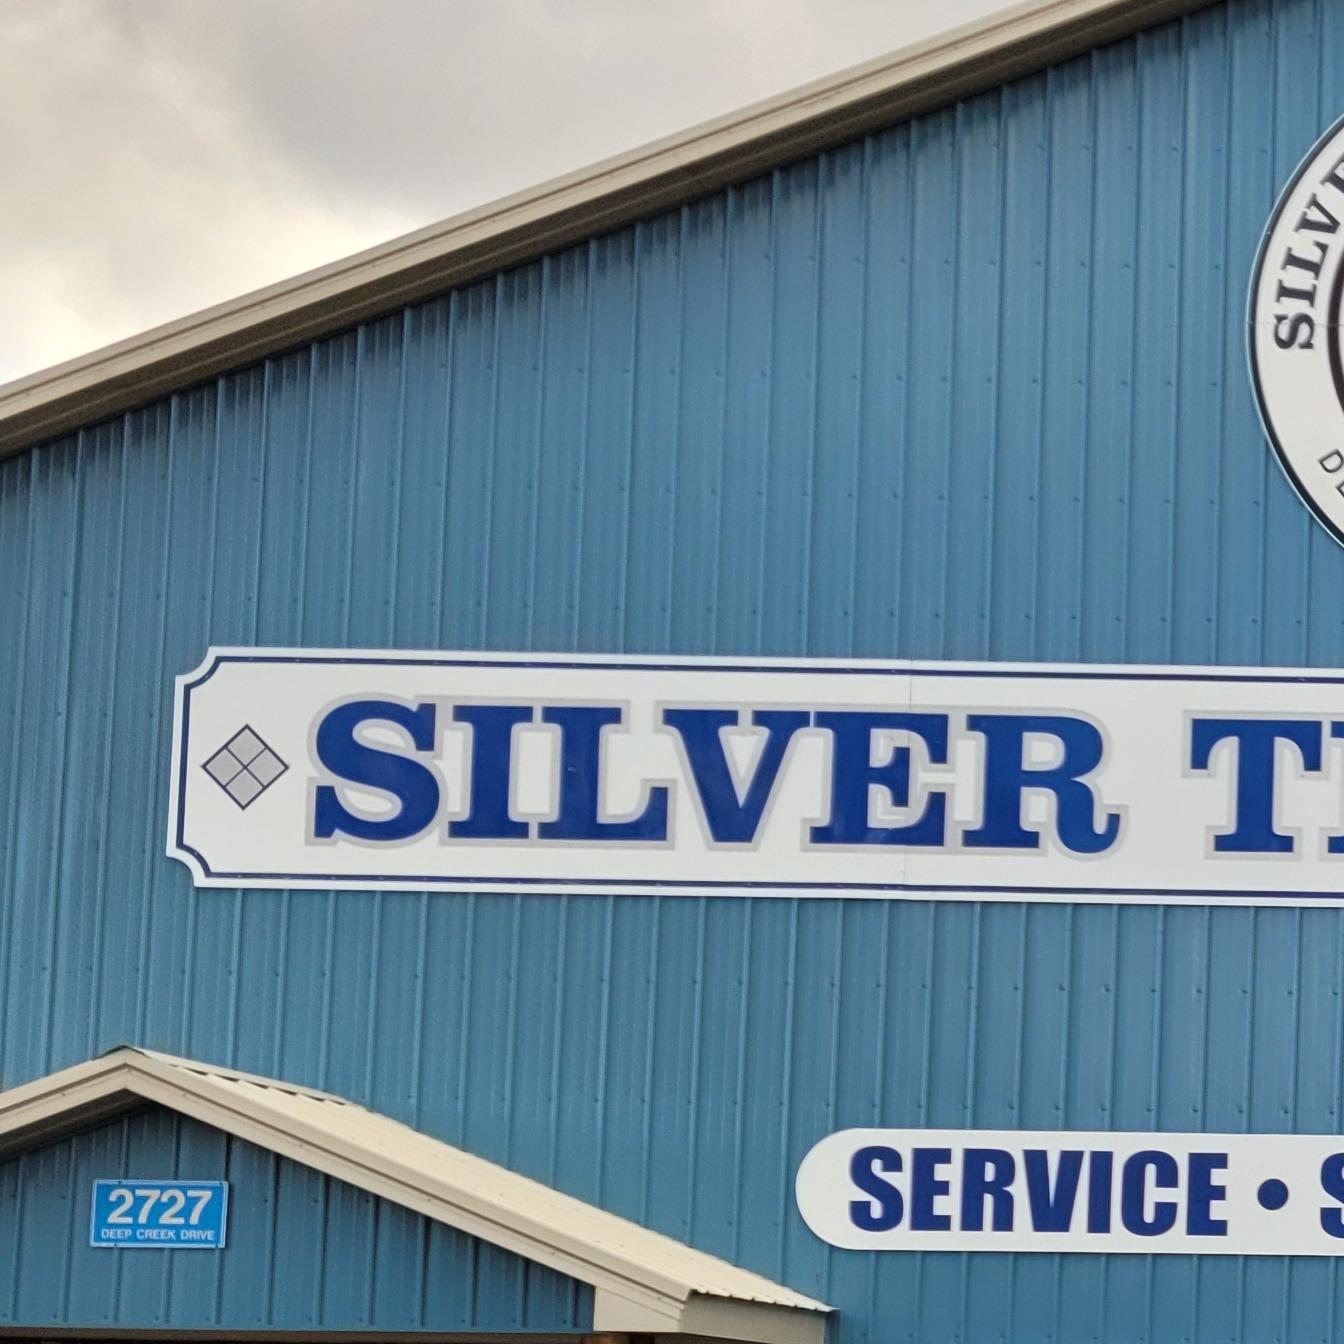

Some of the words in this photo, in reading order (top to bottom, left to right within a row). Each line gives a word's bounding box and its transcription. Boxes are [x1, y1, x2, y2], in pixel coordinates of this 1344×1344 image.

[312, 698, 1121, 856] SILVER
[107, 1187, 213, 1226] 2727
[849, 1145, 1230, 1237] SERVICE
[101, 1228, 132, 1239] DEEP
[136, 1229, 176, 1240] CREEK
[180, 1229, 215, 1241] DRIVE
